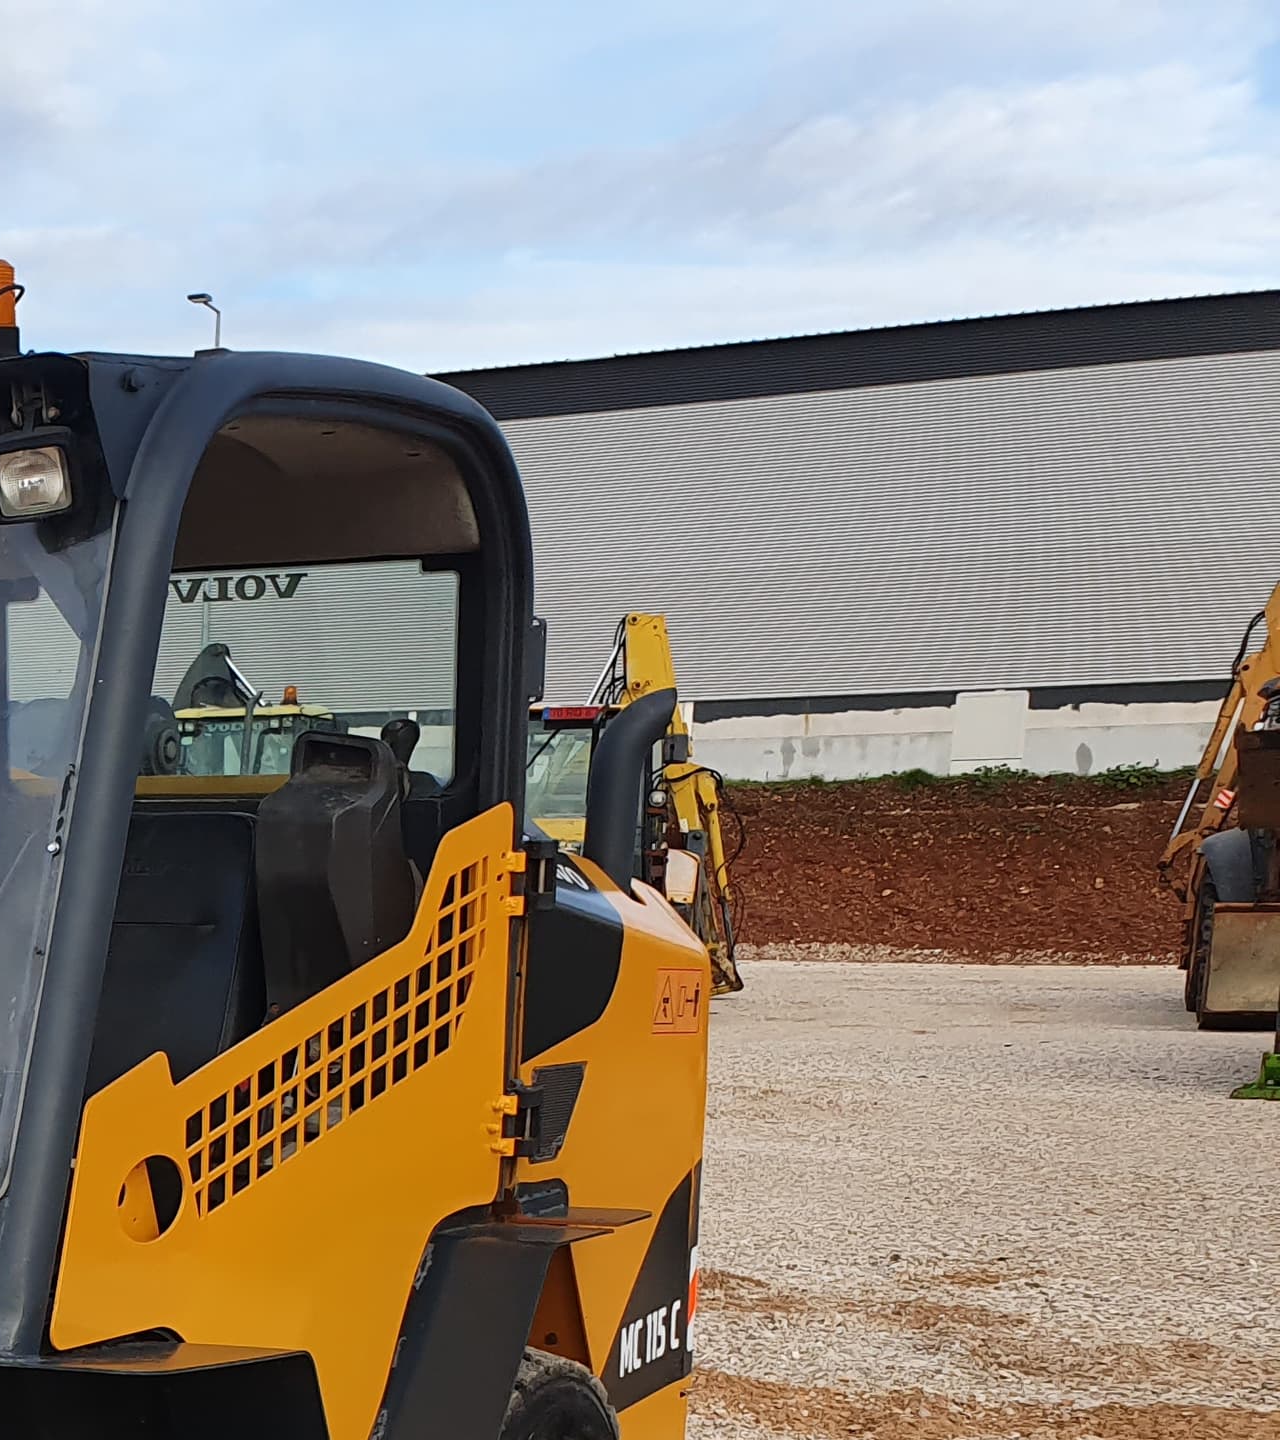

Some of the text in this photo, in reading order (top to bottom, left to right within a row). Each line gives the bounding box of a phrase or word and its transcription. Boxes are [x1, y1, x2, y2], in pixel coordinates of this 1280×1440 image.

[207, 721, 264, 732] VOLO
[619, 1299, 681, 1378] MC 115 C
